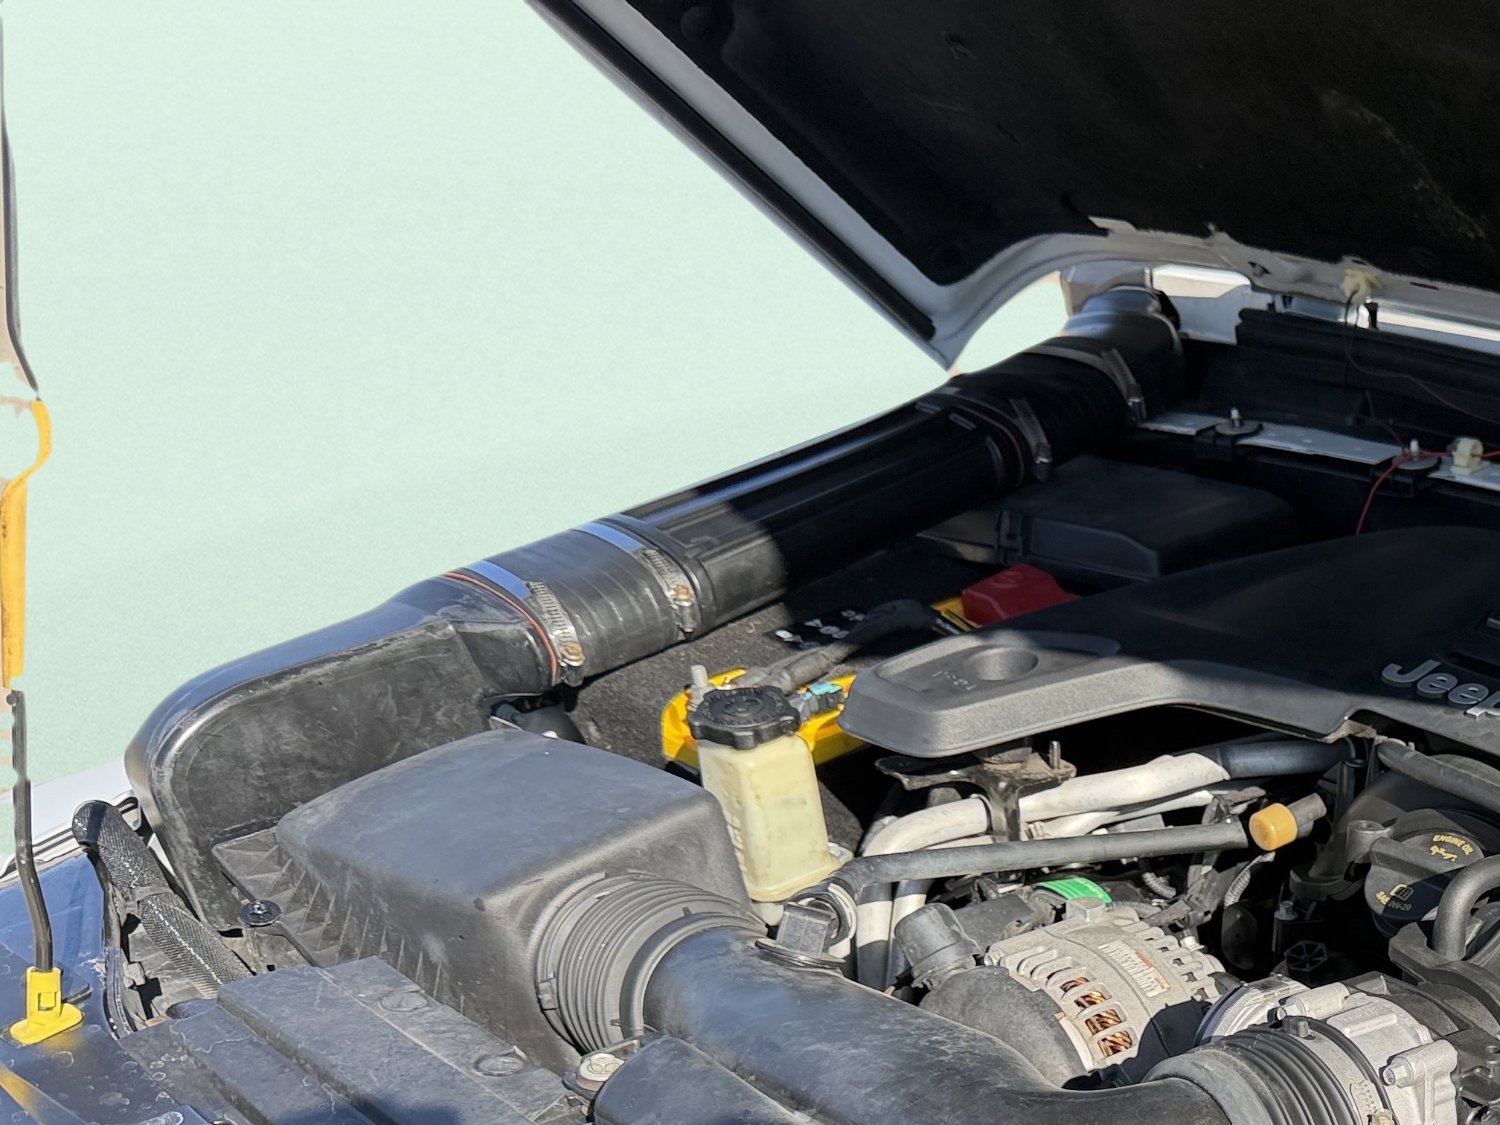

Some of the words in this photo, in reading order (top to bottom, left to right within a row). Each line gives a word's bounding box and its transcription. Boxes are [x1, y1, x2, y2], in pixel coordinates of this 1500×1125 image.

[1433, 834, 1465, 848] ENGINE
[1461, 843, 1473, 855] OIL
[1376, 891, 1390, 905] SAE
